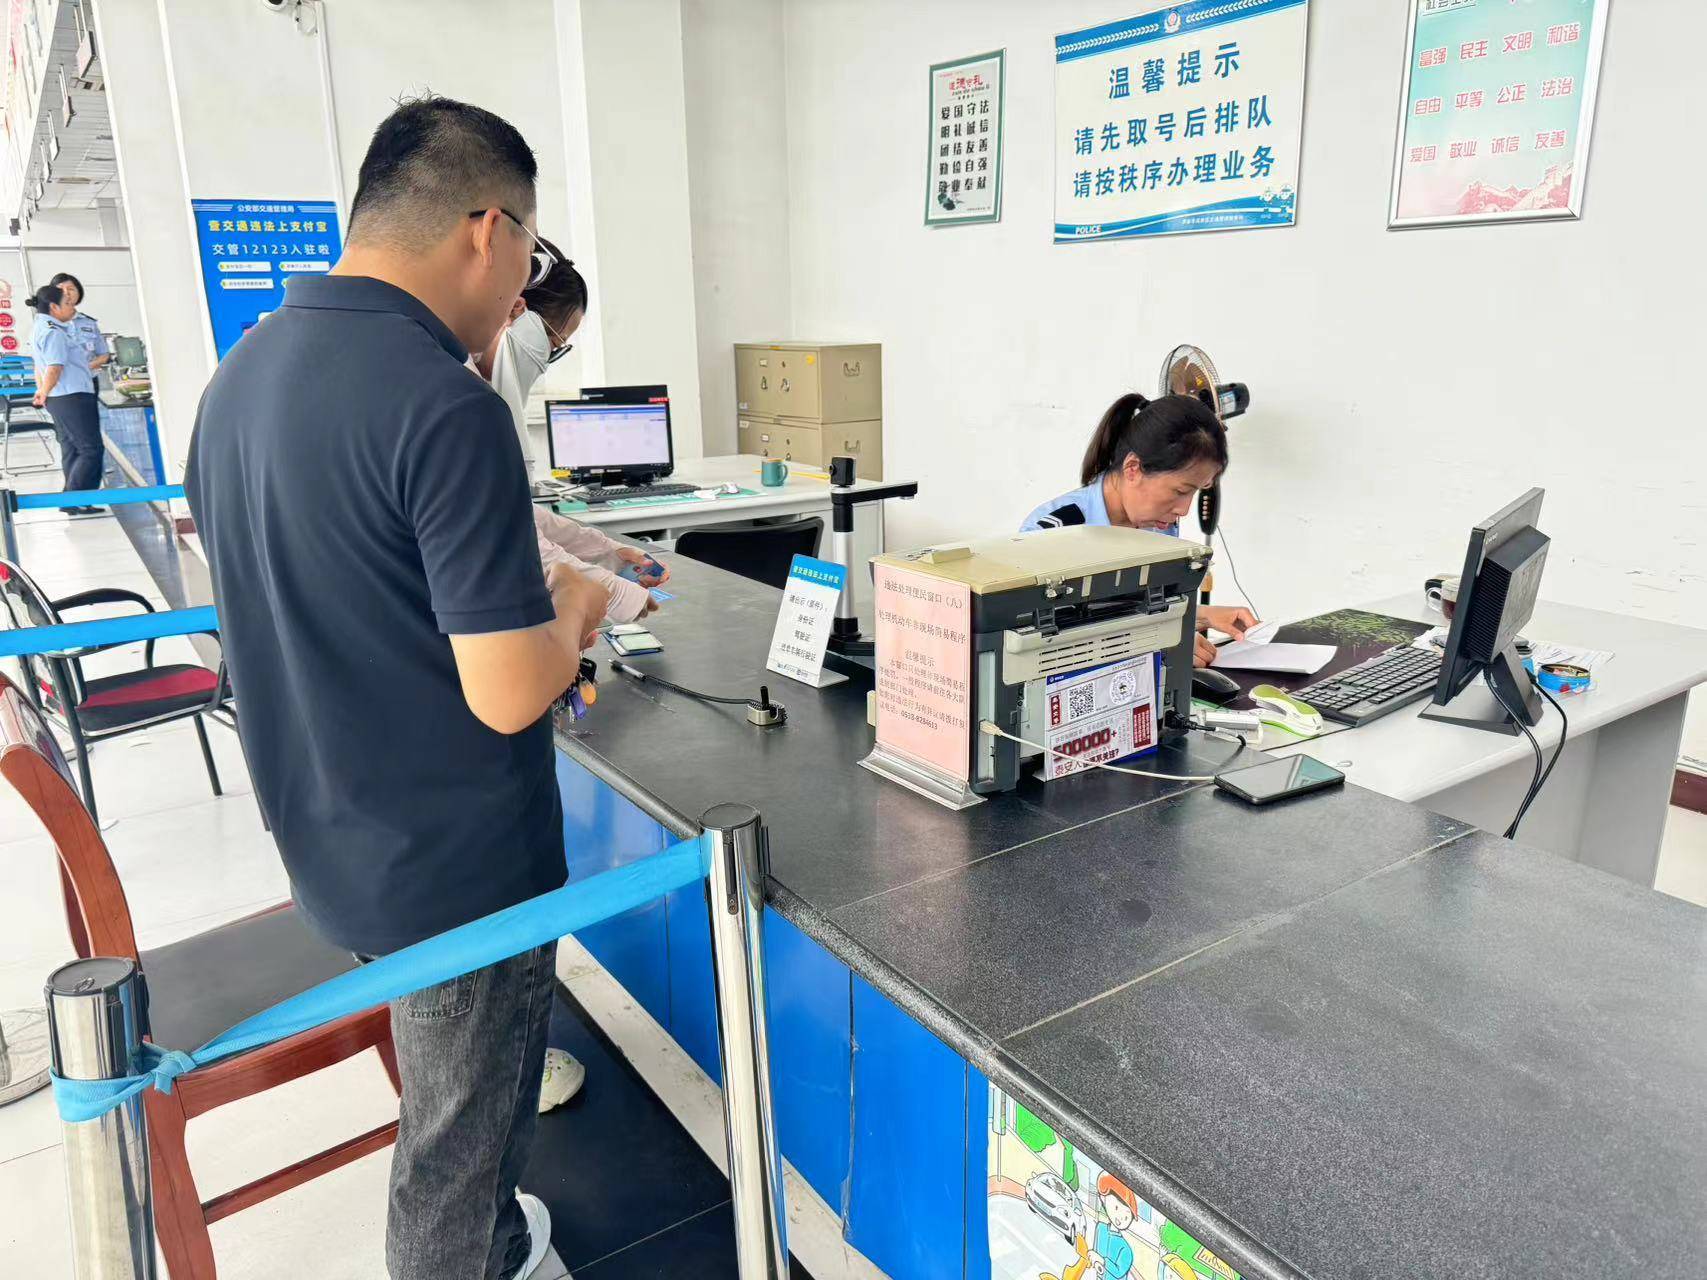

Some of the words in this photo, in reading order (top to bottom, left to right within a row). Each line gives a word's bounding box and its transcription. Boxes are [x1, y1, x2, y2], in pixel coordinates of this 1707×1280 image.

[1419, 48, 1447, 67] 富强
[1460, 41, 1489, 60] 民主
[1502, 32, 1533, 53] 文明
[1547, 24, 1580, 45] 和谐
[1108, 42, 1240, 99] 温馨提示
[1415, 98, 1441, 115] 自由
[1455, 91, 1483, 109] 平等
[1497, 84, 1526, 104] 公正
[1541, 78, 1572, 98] 法治
[941, 100, 989, 120] 爱国守法
[940, 119, 989, 138] 明礼诚信
[1074, 95, 1272, 156] 请先取号后排队
[940, 138, 988, 157] 团结友善
[1410, 146, 1437, 162] 爱国
[1449, 141, 1477, 159] 敬业
[1491, 136, 1520, 154] 诚信
[1534, 130, 1566, 150] 友善
[939, 157, 987, 175] 勤俭自强
[1073, 145, 1275, 199] 请按秩序办理业务
[1075, 225, 1101, 235] POLICE
[212, 244, 330, 255] 交管12123入驻啦
